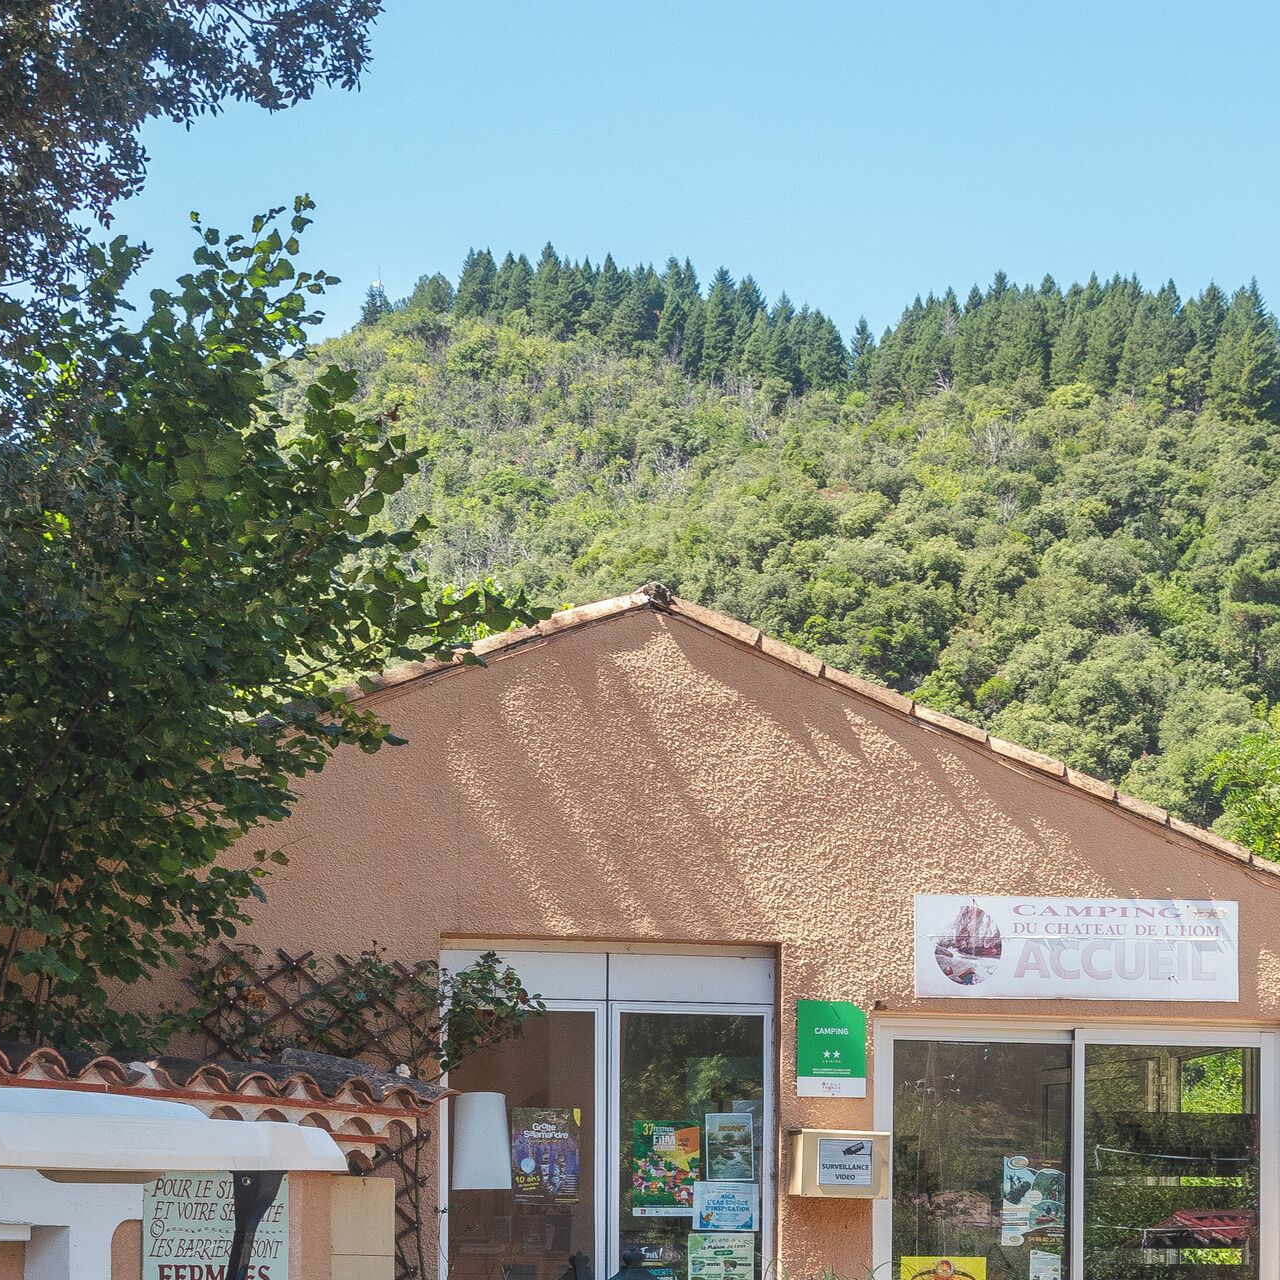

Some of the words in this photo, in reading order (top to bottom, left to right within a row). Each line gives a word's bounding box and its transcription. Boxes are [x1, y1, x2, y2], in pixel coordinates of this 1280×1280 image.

[1013, 904, 1182, 919] CAMPING
[1013, 922, 1038, 935] DU
[1044, 922, 1127, 936] CHATEAU
[1135, 924, 1157, 936] DE
[1013, 940, 1217, 981] ACCUEIL
[814, 1027, 849, 1035] CAMPING
[643, 1123, 654, 1135] 37
[821, 1163, 869, 1171] SURVEILLANCE
[151, 1178, 193, 1199] POUR
[194, 1180, 214, 1199] LE
[152, 1201, 175, 1220] ET
[177, 1201, 219, 1221] VOTRE
[149, 1237, 176, 1258] LES
[250, 1239, 283, 1259] SONT
